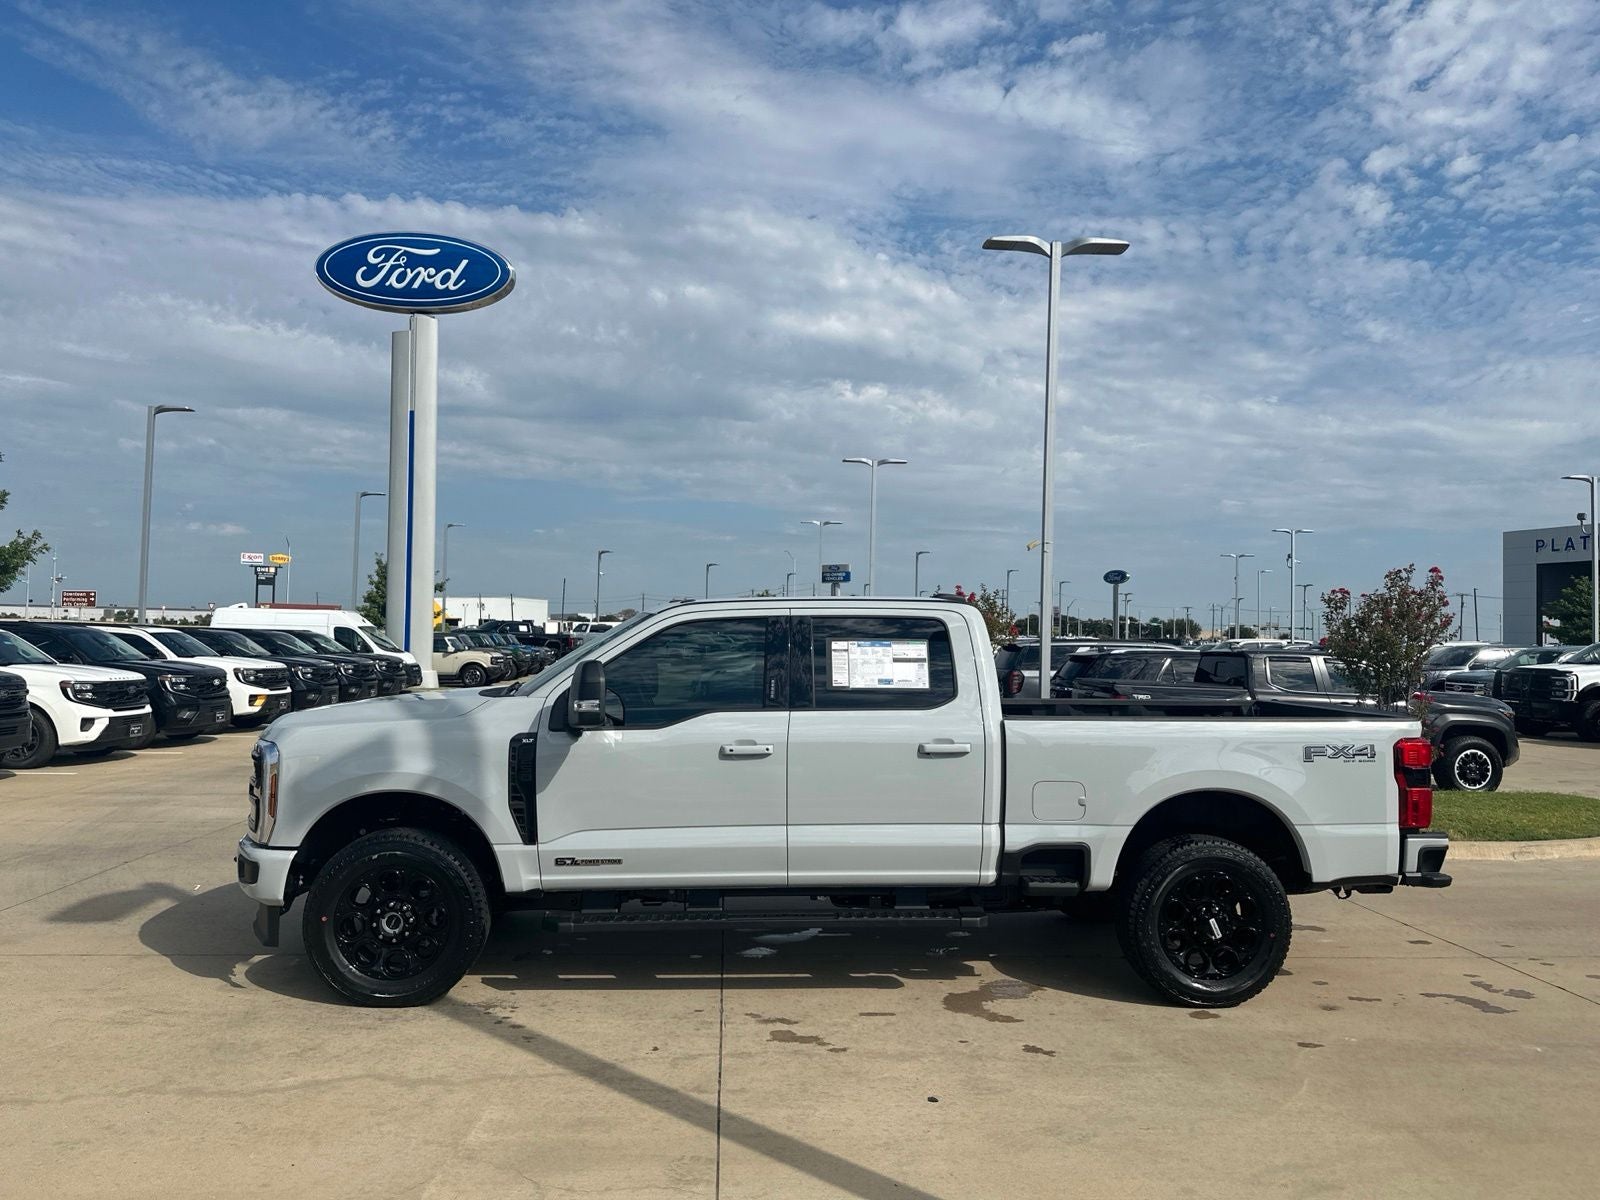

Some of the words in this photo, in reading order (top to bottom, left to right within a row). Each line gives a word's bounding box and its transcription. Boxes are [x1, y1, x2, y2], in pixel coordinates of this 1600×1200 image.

[355, 244, 469, 290] Ford
[242, 553, 263, 561] Exxon
[1303, 744, 1376, 763] FX4
